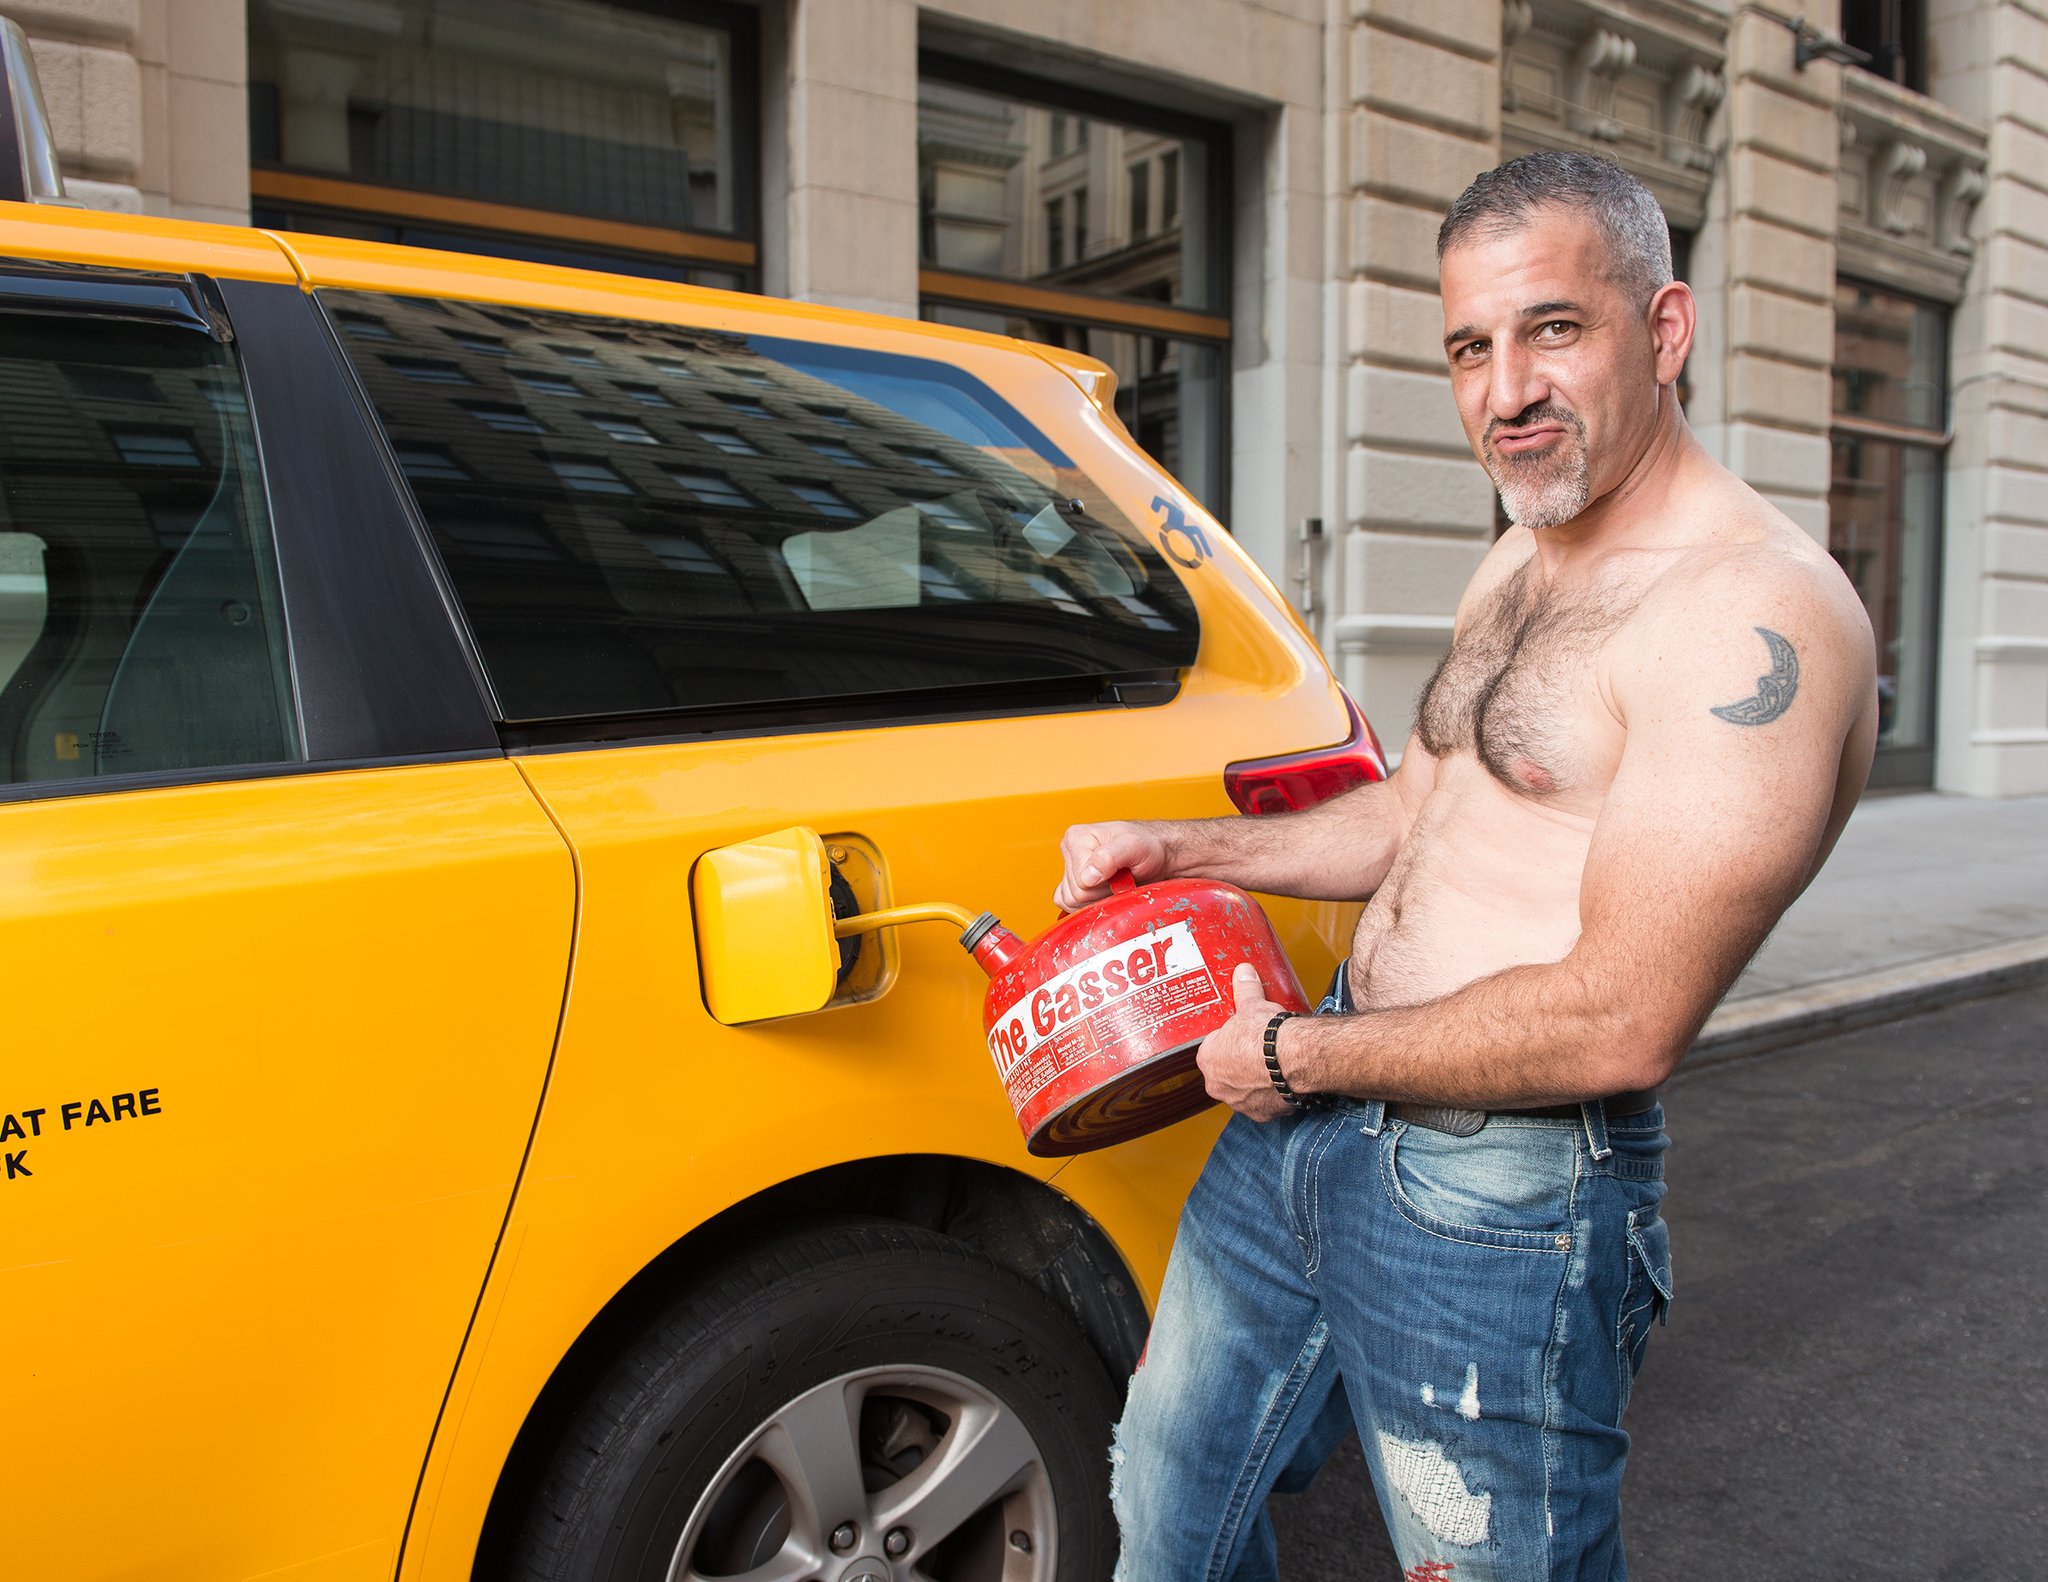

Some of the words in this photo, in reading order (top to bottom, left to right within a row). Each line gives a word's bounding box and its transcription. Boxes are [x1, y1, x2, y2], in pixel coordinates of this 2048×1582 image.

[990, 1017, 1027, 1079] The
[1031, 936, 1173, 1037] Gasser
[1126, 982, 1168, 1004] DANGER
[1007, 1056, 1033, 1084] GASOLINE
[0, 1108, 46, 1142] AT
[61, 1088, 161, 1130] FARE
[0, 1149, 33, 1179] K
